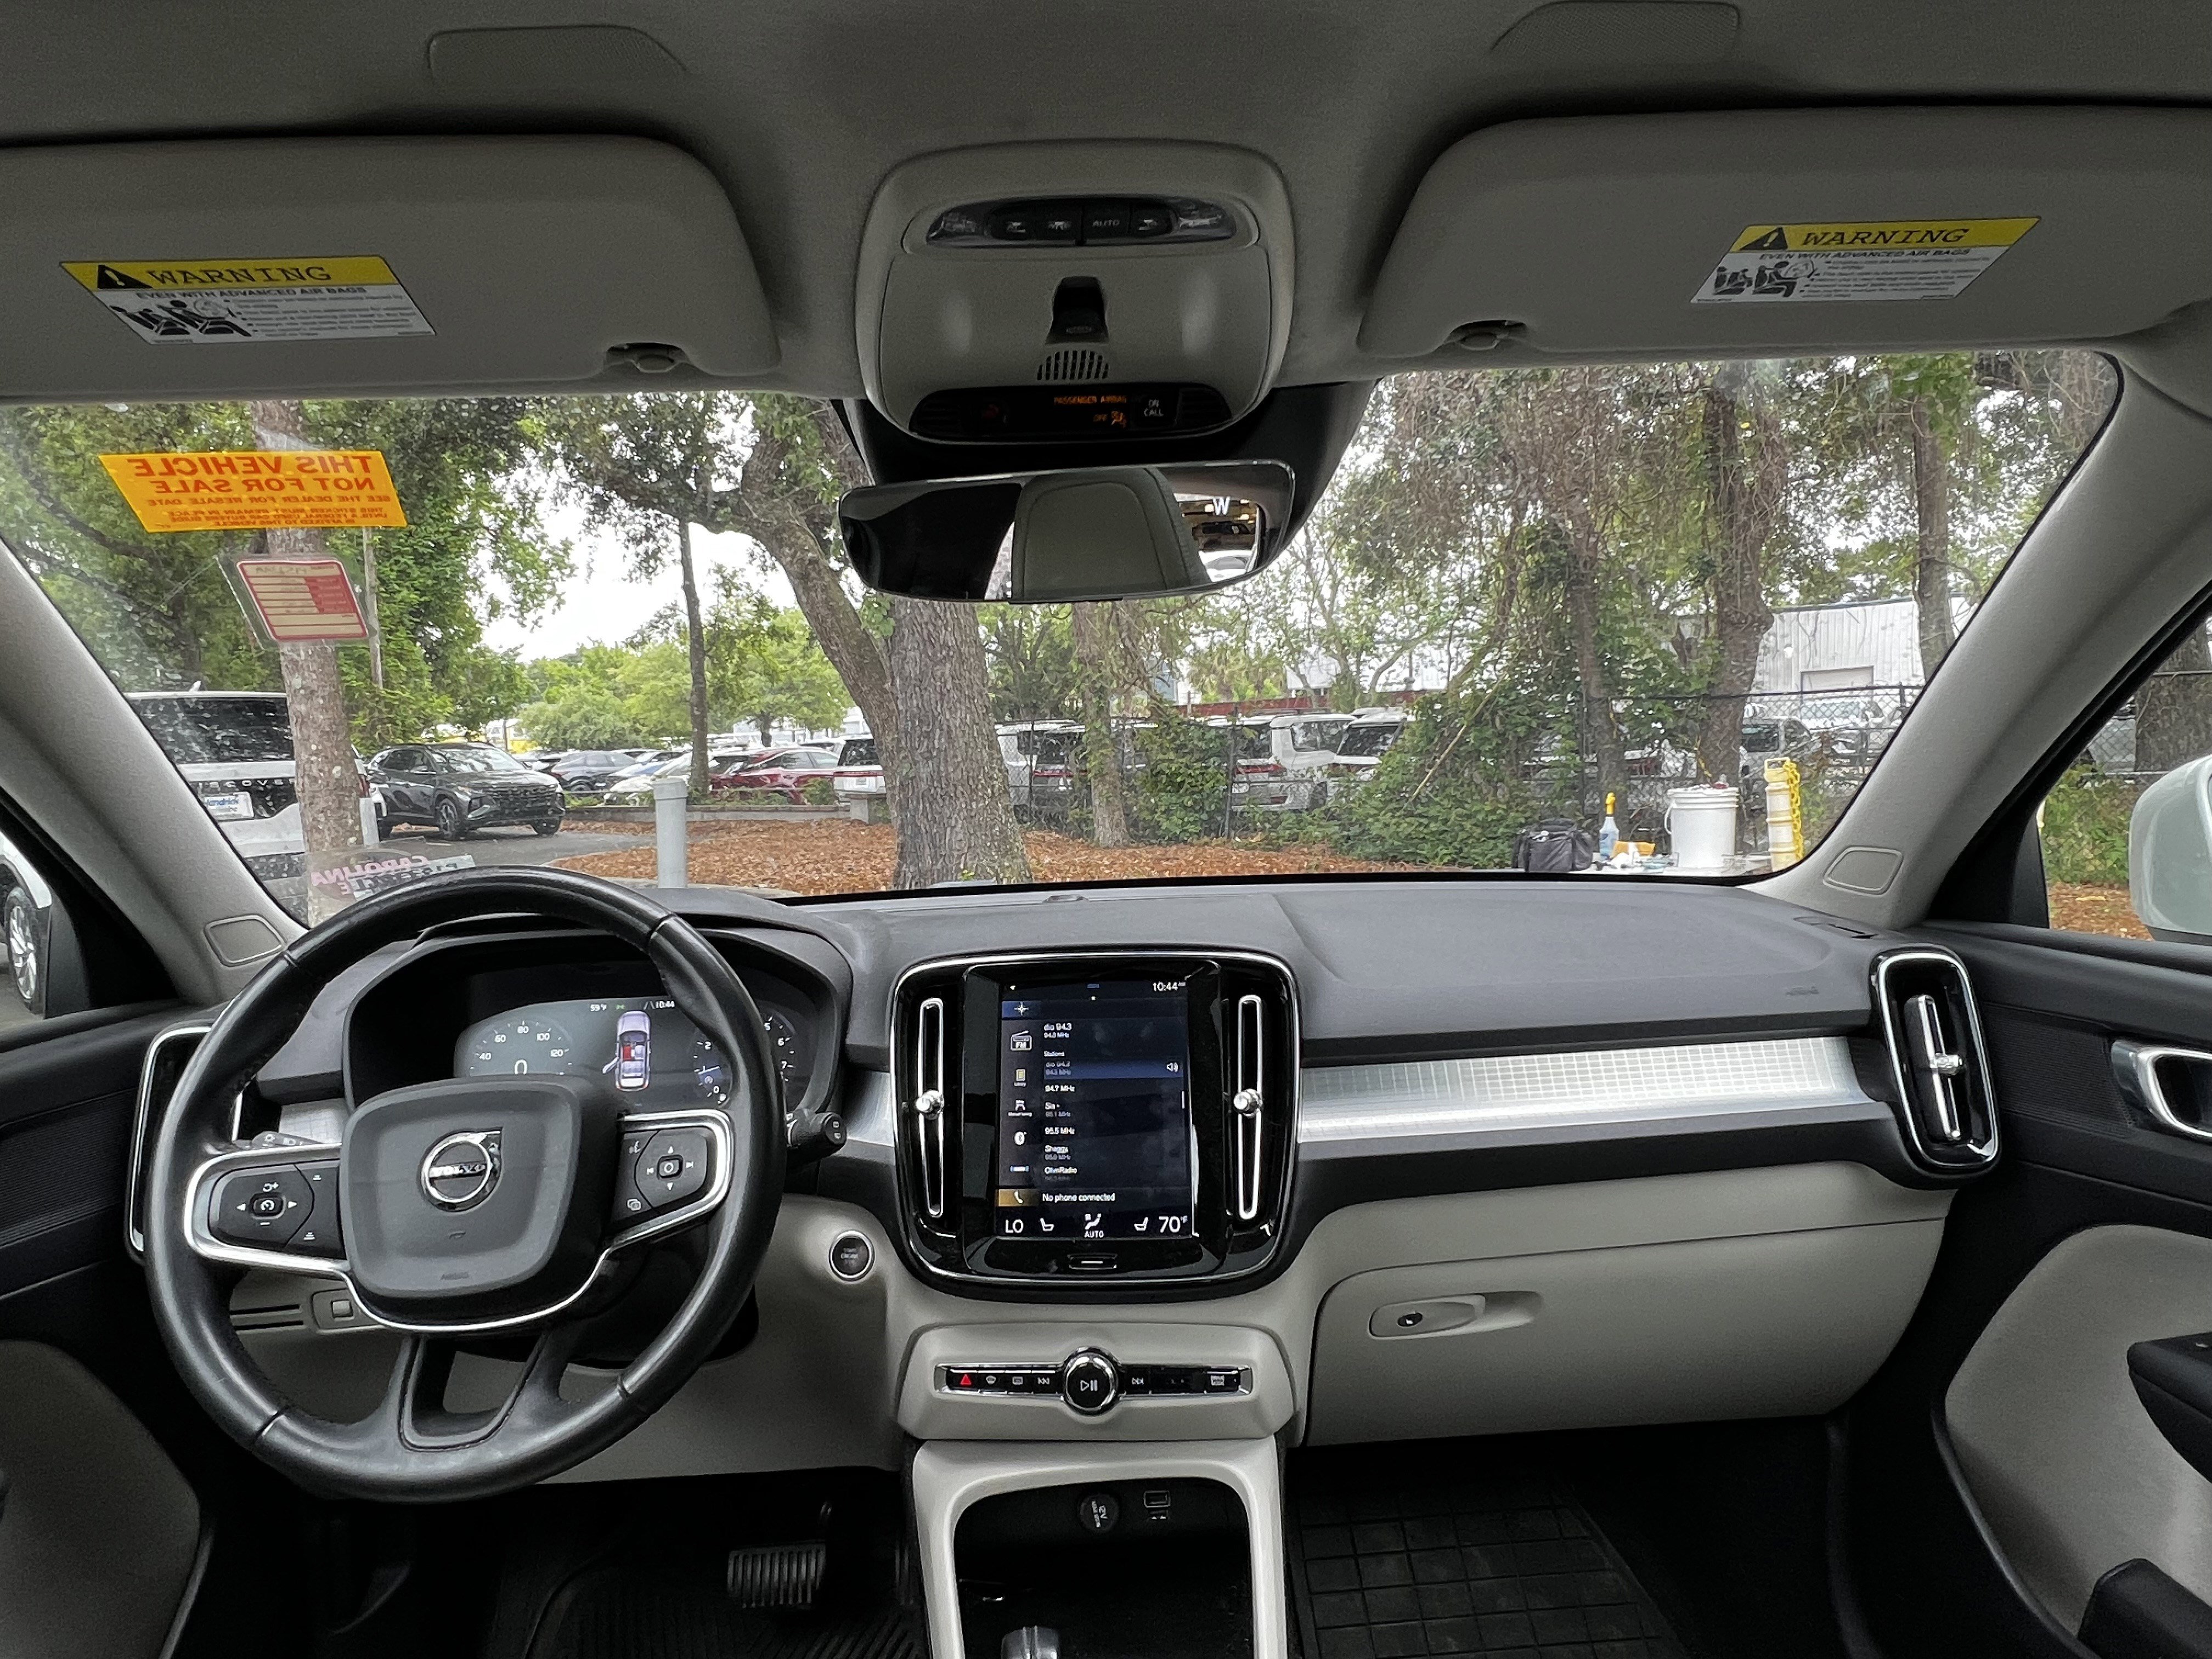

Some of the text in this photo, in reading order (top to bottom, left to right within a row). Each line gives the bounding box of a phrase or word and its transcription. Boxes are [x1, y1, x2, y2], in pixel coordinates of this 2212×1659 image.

[1801, 228, 1970, 246] WARNING
[146, 267, 331, 284] WARNING
[219, 289, 296, 297] ADVANCED
[1143, 408, 1164, 417] CALL
[494, 1034, 506, 1042] 60
[537, 1032, 550, 1041] 100
[705, 1041, 712, 1049] 2
[778, 1037, 785, 1047] 6
[479, 1052, 492, 1060] 40
[550, 1048, 564, 1058] 120
[781, 1060, 788, 1069] 7
[713, 1085, 720, 1094] 0
[1042, 1193, 1116, 1203] No phone connected
[1005, 1218, 1024, 1233] LO
